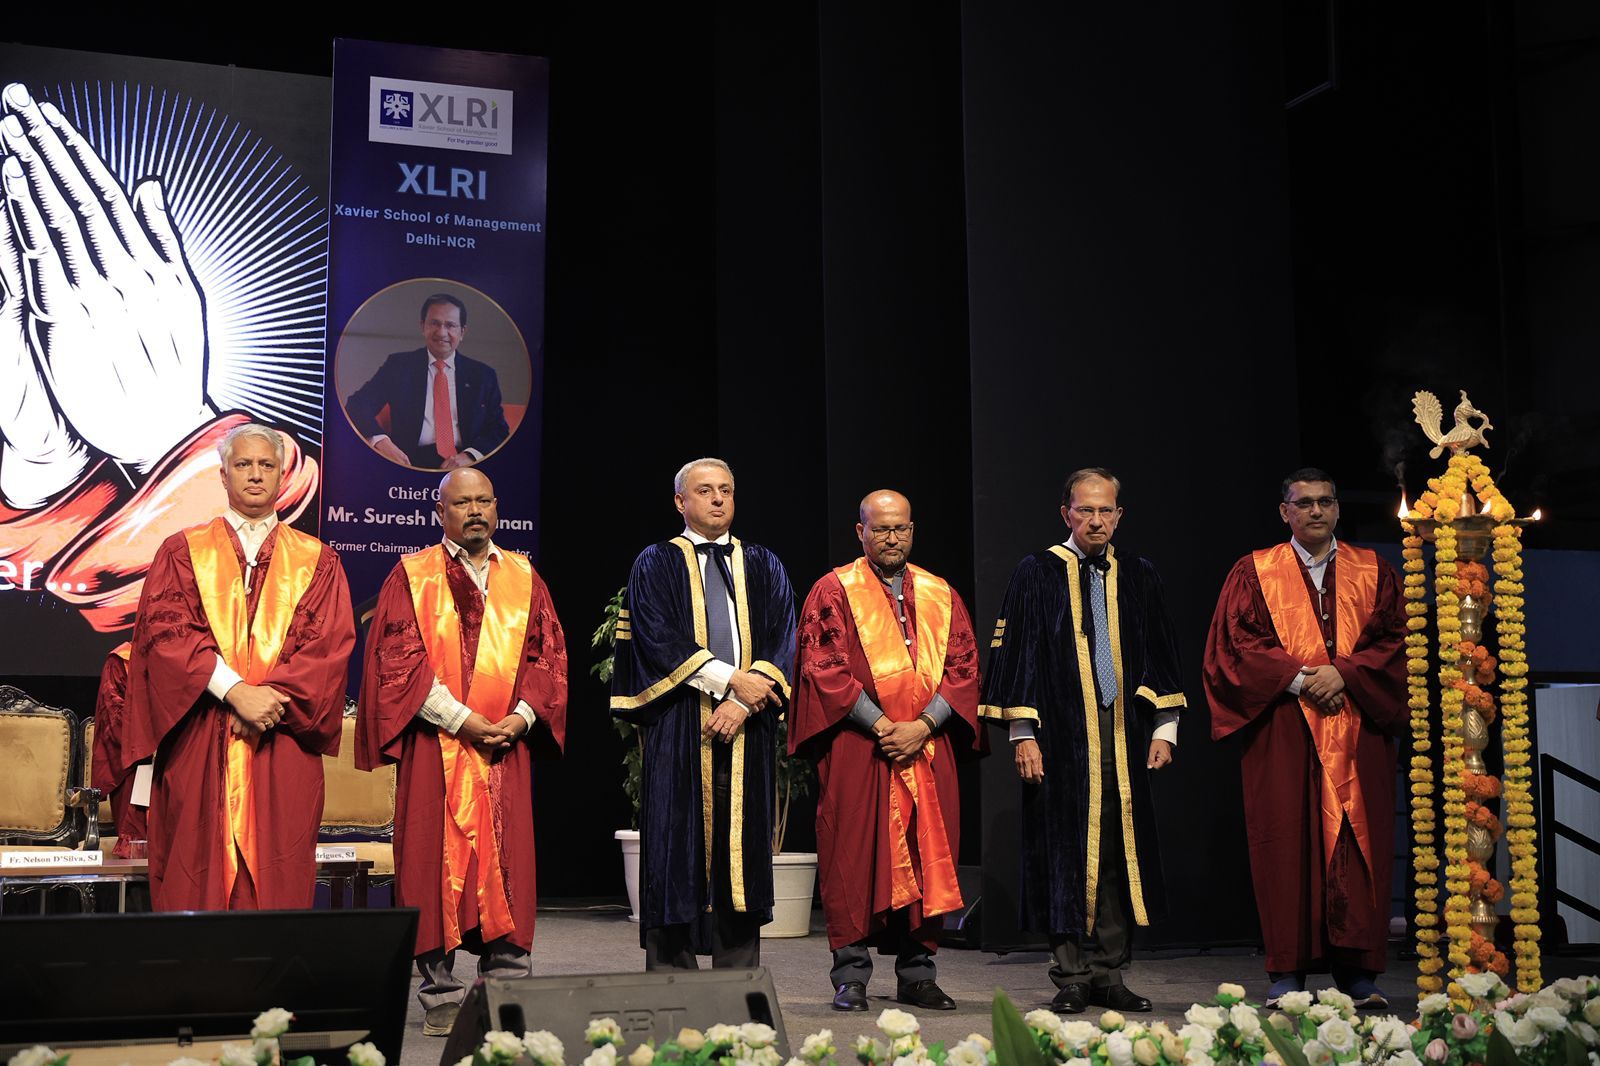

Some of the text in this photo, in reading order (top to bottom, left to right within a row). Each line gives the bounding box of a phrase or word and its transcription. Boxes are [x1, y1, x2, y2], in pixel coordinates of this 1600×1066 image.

[397, 162, 487, 200] XLRI
[335, 204, 542, 232] Xavier School of Management
[406, 232, 476, 249] Delhi-NCR
[388, 486, 429, 501] Chief
[327, 505, 359, 523] Mr.
[363, 507, 426, 526] Suresh
[329, 540, 367, 552] Former
[369, 542, 420, 554] Chairman
[9, 856, 21, 864] Fr.
[53, 855, 86, 863] D'Silva,
